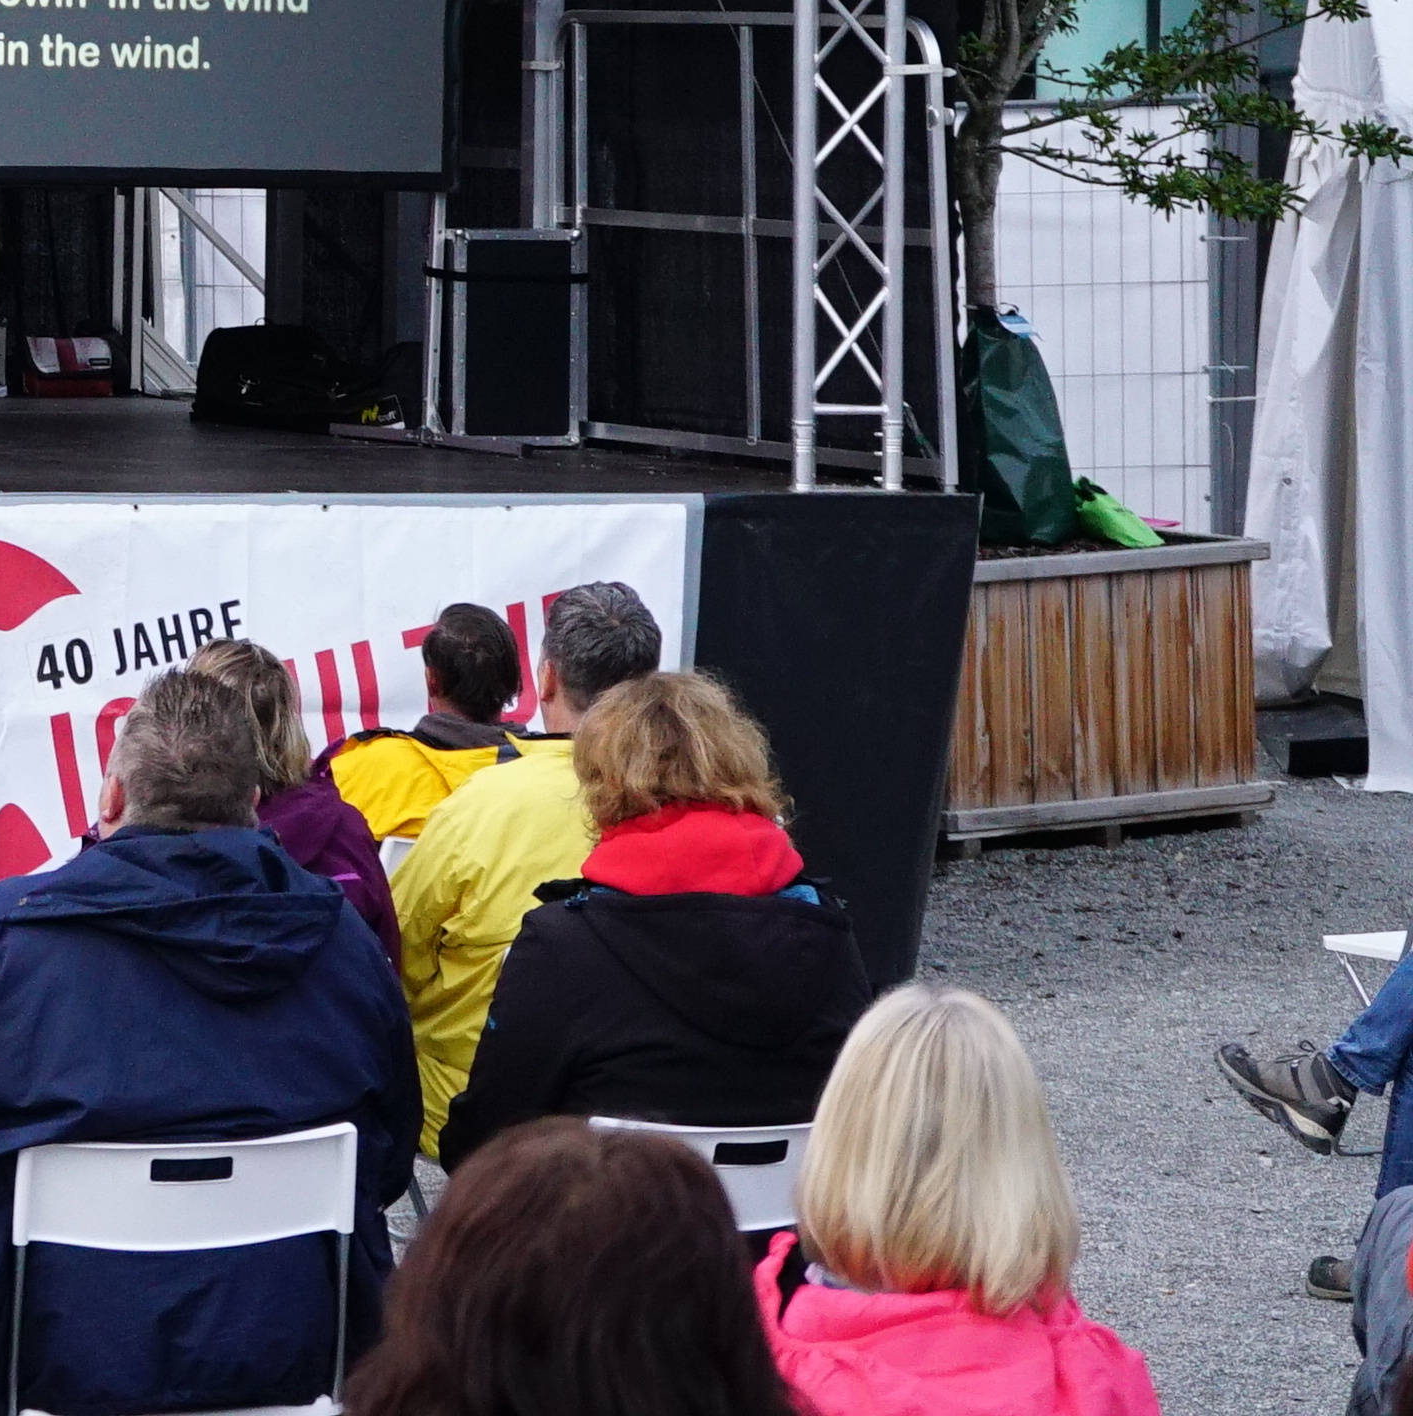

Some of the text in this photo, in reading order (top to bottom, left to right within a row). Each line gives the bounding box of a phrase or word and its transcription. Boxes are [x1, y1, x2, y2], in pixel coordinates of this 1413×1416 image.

[39, 33, 101, 68] the
[110, 35, 211, 70] wind.
[36, 598, 243, 691] 40 JAHRE
